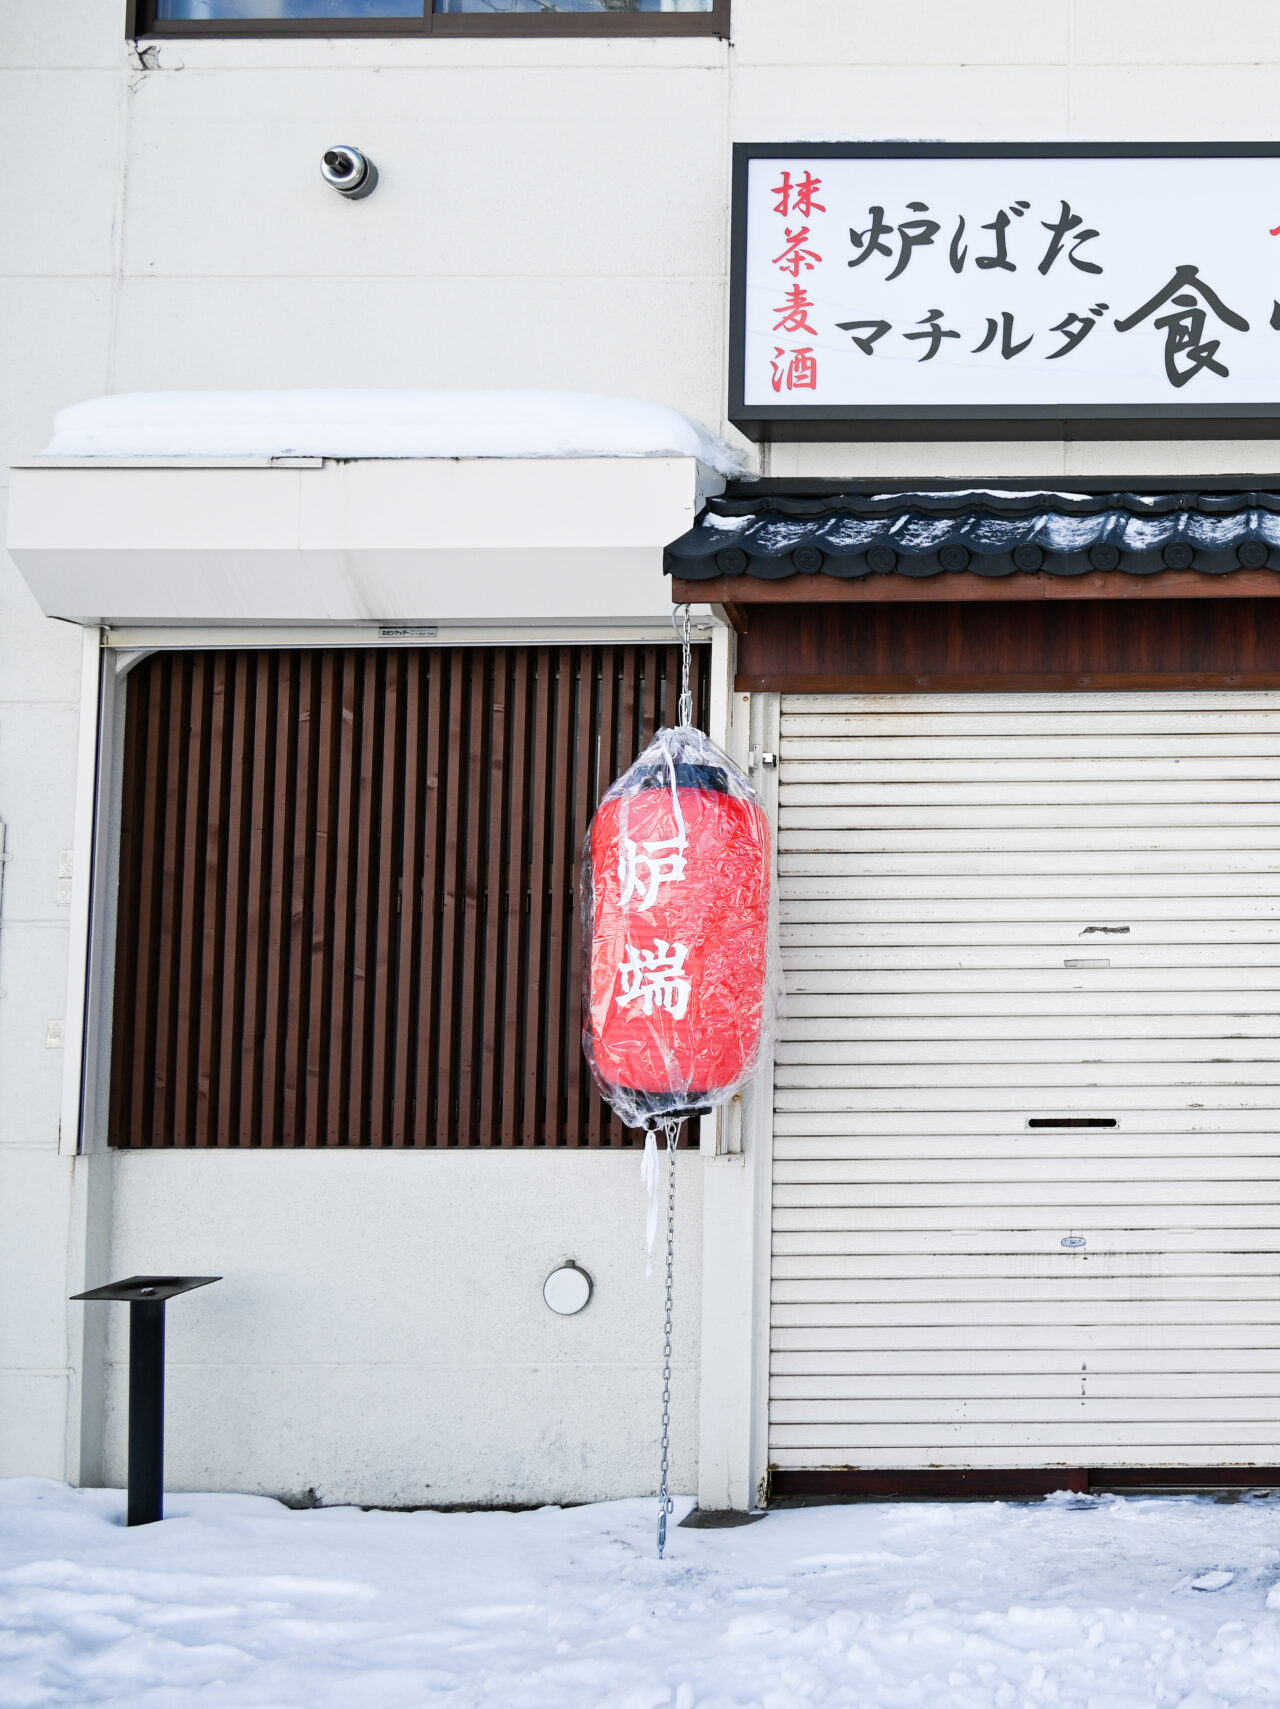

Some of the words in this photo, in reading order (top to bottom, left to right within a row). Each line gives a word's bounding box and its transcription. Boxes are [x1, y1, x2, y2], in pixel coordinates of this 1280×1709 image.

[771, 170, 826, 392] 抹茶麦酒
[847, 199, 1104, 281] 炉ばた
[835, 302, 1110, 363] マチルダ
[616, 838, 692, 1020] 炉端
